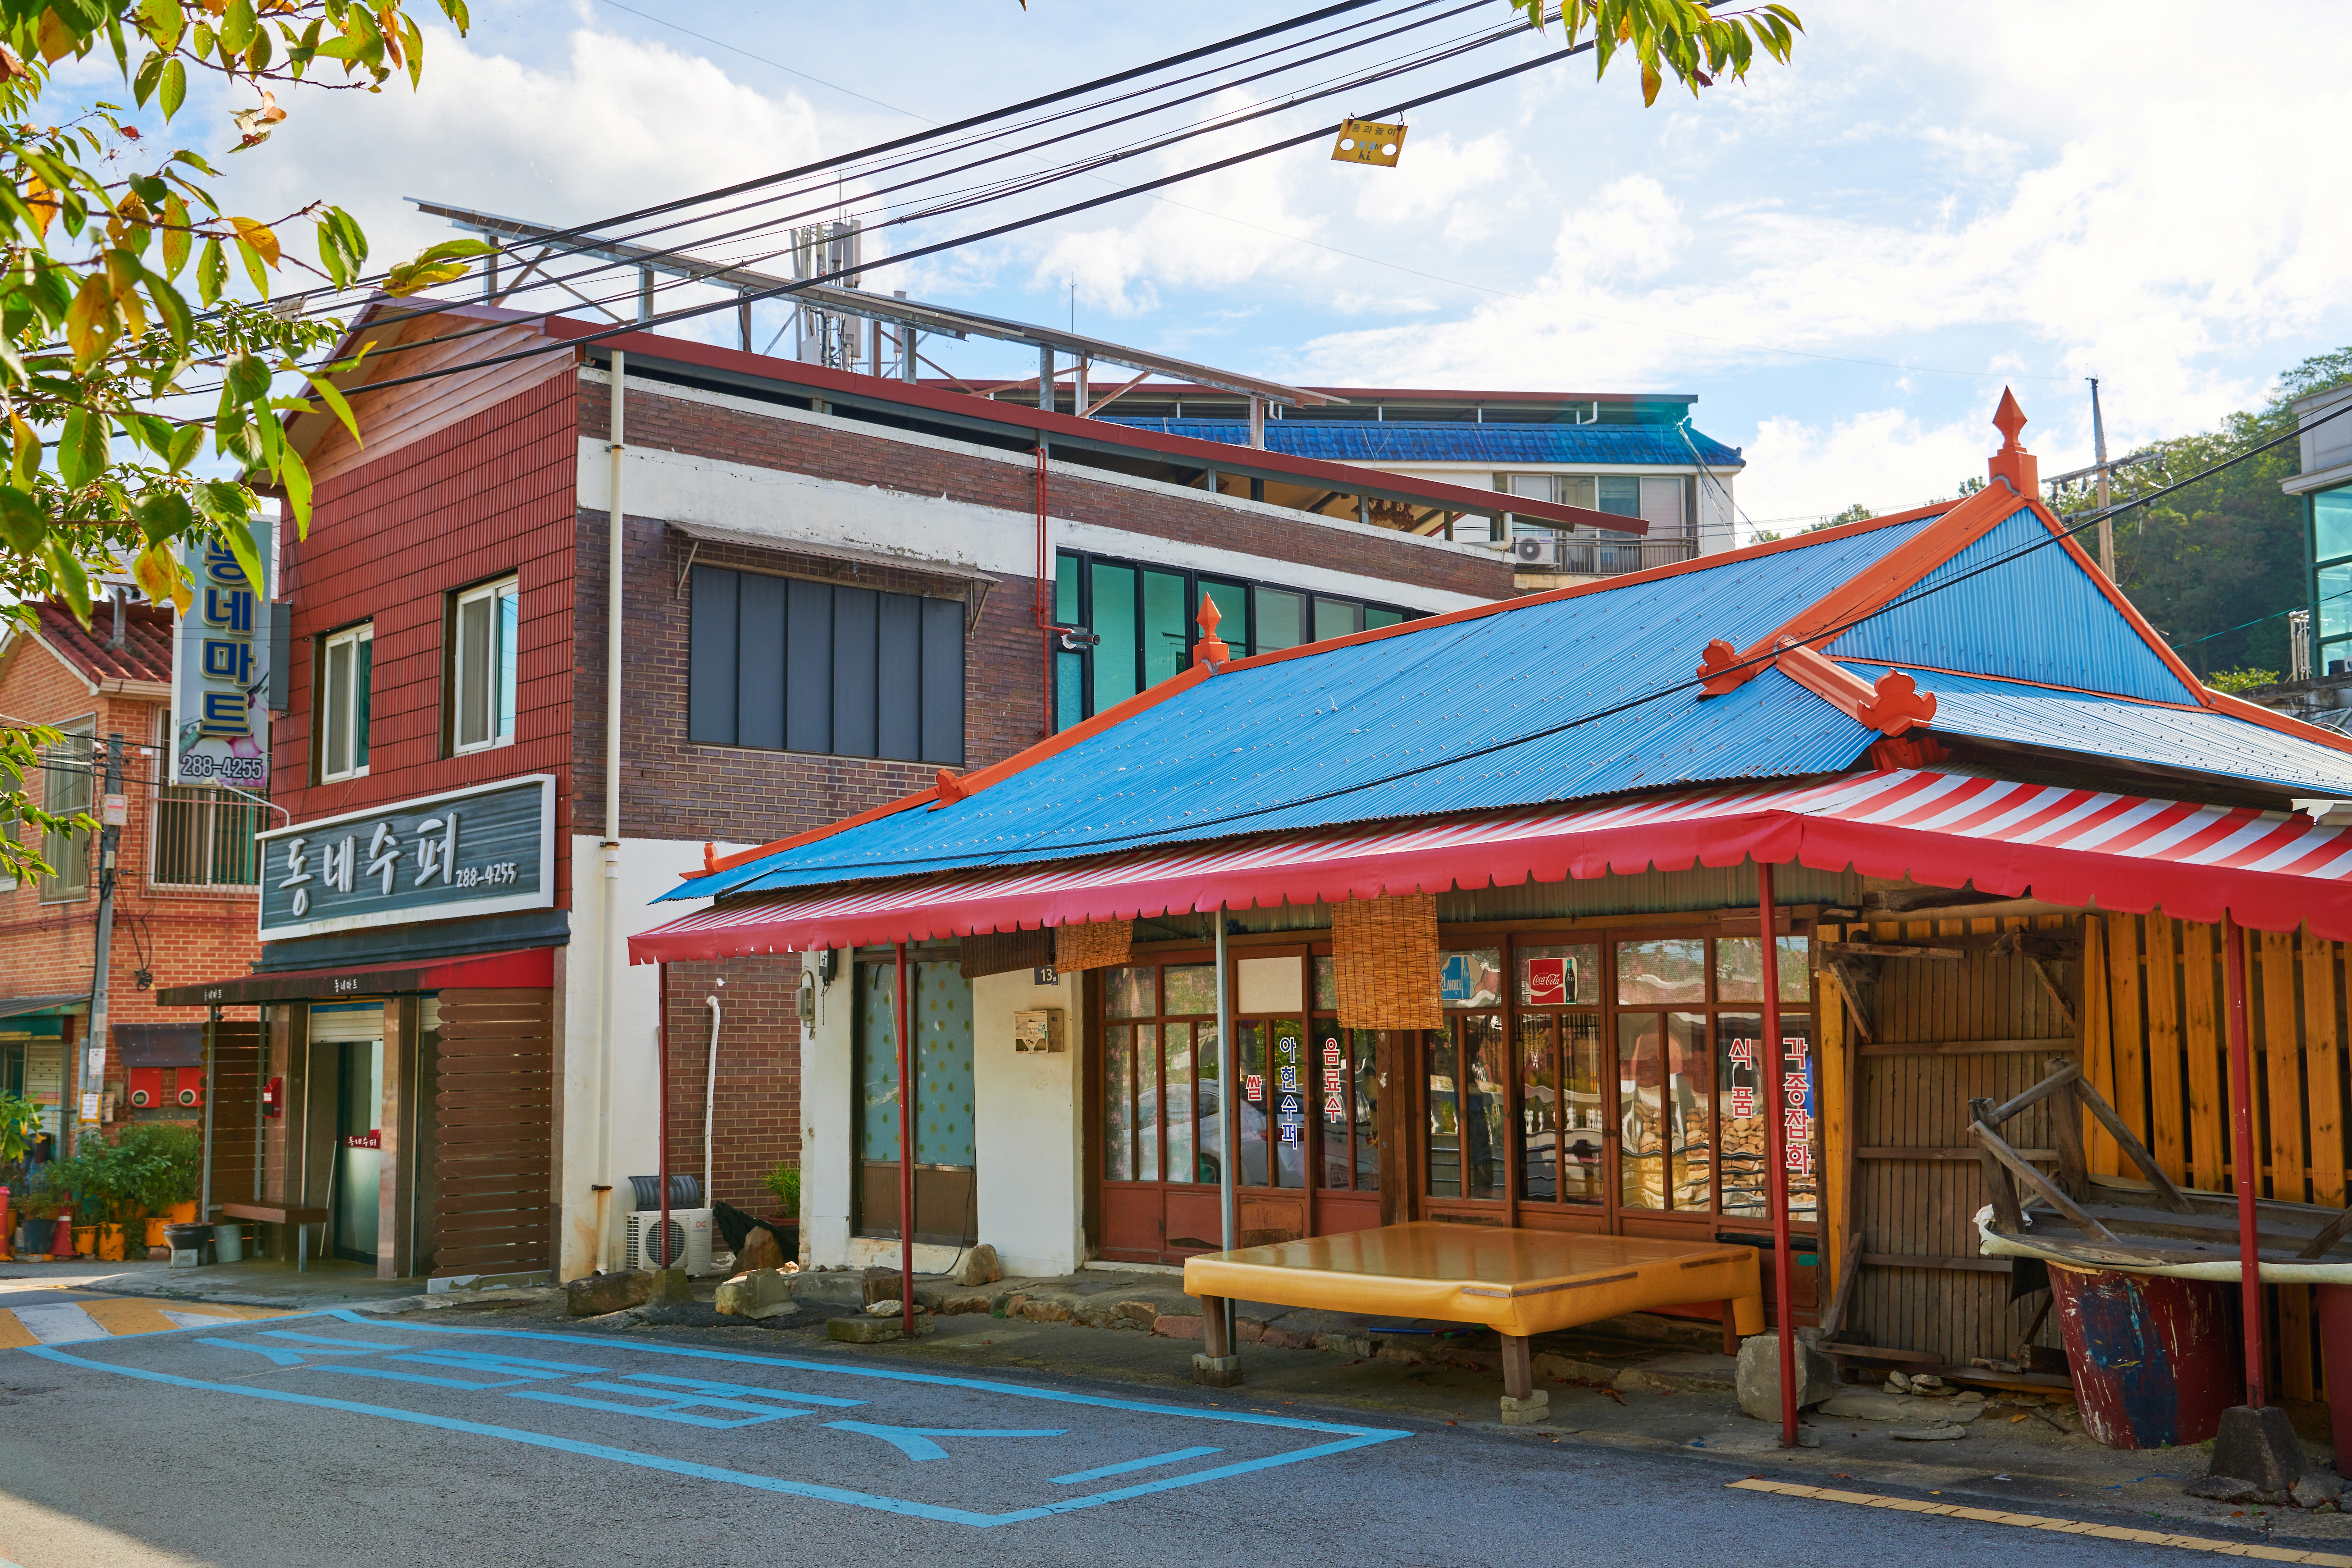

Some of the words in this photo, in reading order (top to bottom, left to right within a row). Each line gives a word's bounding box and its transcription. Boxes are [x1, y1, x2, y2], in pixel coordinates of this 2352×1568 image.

[1352, 124, 1396, 137] 통과높이
[180, 754, 263, 780] 288-4255
[279, 813, 457, 916] 동네수퍼
[456, 862, 517, 888] 288-4255
[335, 979, 357, 992] 동네마트
[1041, 969, 1052, 981] 13
[1533, 974, 1561, 986] Coca-Cola
[1245, 1074, 1262, 1101] 쌀
[1323, 1037, 1342, 1123] 음료수
[1728, 1038, 1754, 1119] 식품
[1279, 1037, 1298, 1150] 아현수퍼
[1783, 1037, 1811, 1177] 각종잡화
[348, 1136, 376, 1147] 동네수퍼
